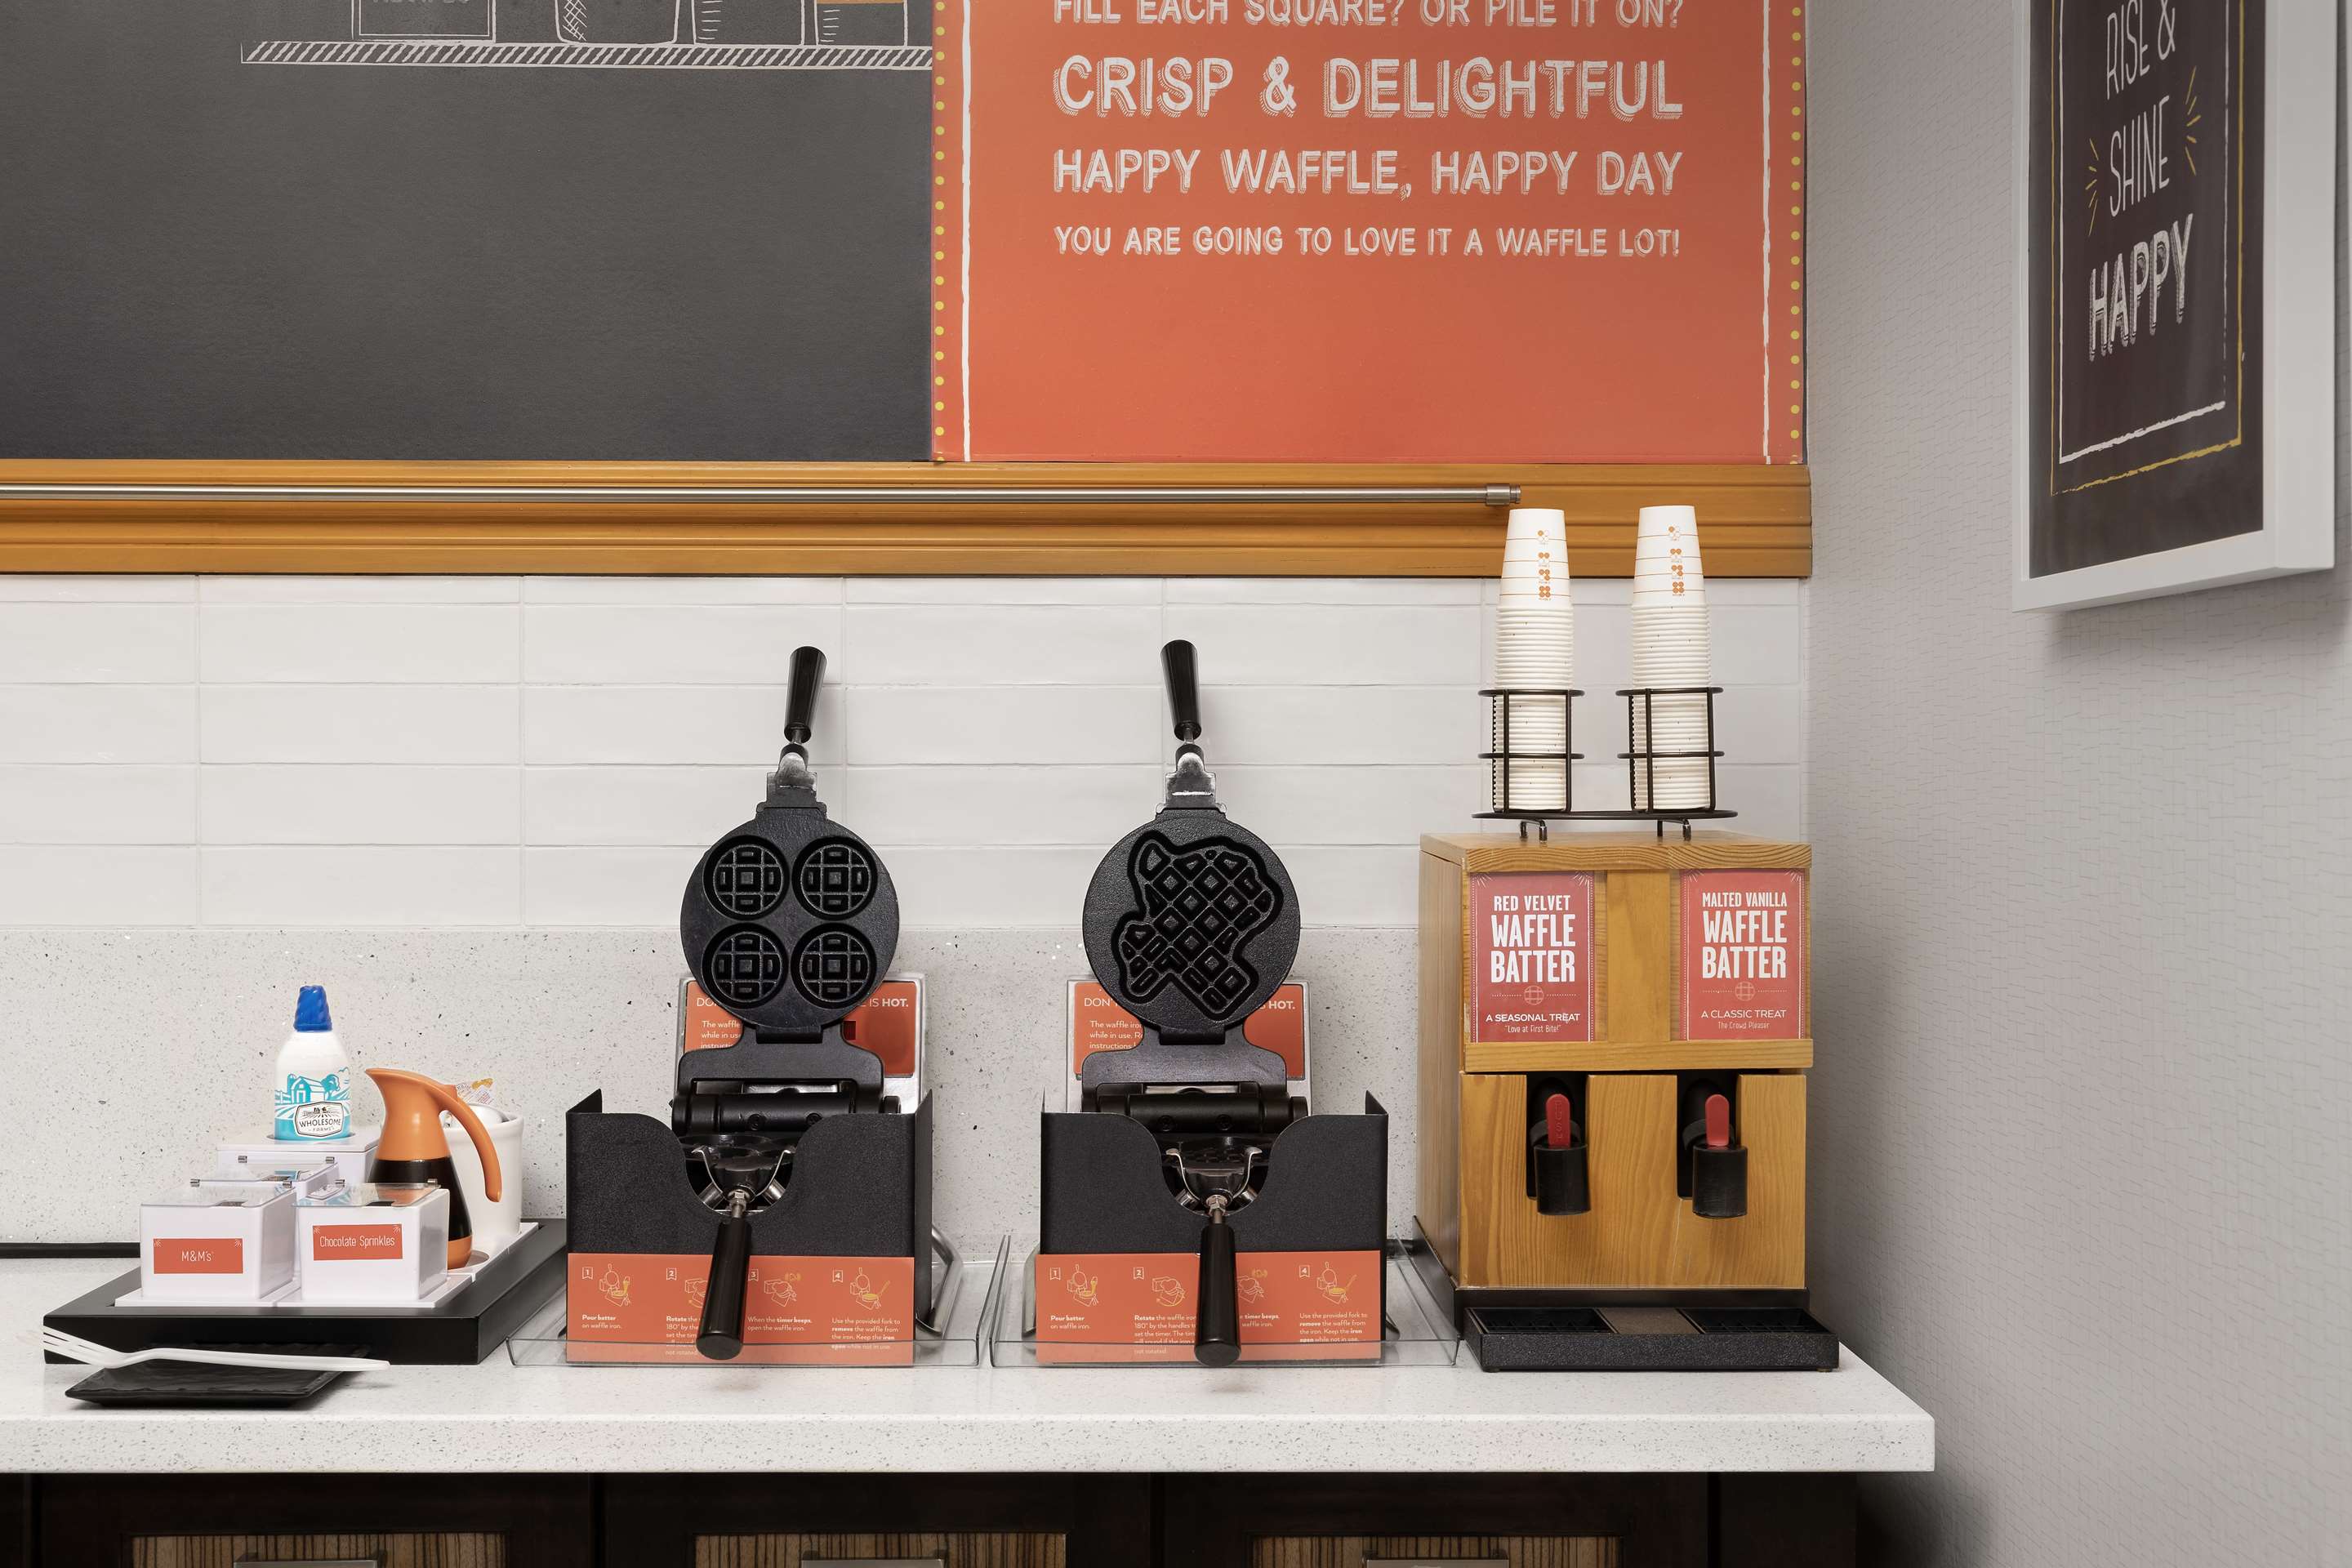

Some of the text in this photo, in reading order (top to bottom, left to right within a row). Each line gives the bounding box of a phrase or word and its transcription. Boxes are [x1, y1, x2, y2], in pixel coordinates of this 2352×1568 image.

[1054, 0, 1682, 28] FILL EACH SQUARE? OR PILE IT ON?
[2107, 0, 2175, 99] RISE &
[1053, 55, 1684, 121] CRISP & DELIGHTFUL
[2109, 95, 2170, 217] SHINE
[1054, 149, 1683, 202] HAPPY WAFFLE, HAPPY DAY
[1054, 225, 1679, 257] YOU ARE GOING TO LOVE IT A WAFFLE LOT!
[2088, 213, 2194, 363] HAPPY
[1494, 895, 1570, 911] RED VELVET
[1702, 892, 1787, 907] MALTED VANILLA
[1491, 914, 1575, 947] WAFFLE
[1702, 910, 1787, 944] WAFFLE
[1490, 950, 1575, 983] BATTER
[1702, 946, 1787, 979] BATTER
[869, 998, 909, 1007] IS HOT.
[1084, 998, 1118, 1007] DON'
[1268, 1000, 1296, 1009] HOT.
[1486, 1013, 1581, 1022] A SEASONAL TREAT
[1701, 1009, 1787, 1018] A CLASSIC TREAT
[702, 1020, 741, 1028] The waffle
[1090, 1020, 1104, 1028] The
[1106, 1020, 1129, 1028] waffle
[1530, 1025, 1544, 1033] First
[1717, 1021, 1770, 1029] The Crowd Pleaser
[702, 1031, 720, 1039] while
[1089, 1031, 1108, 1039] while
[299, 1118, 341, 1128] WHOLESOME
[319, 1234, 395, 1249] Chocolate Sprinkles
